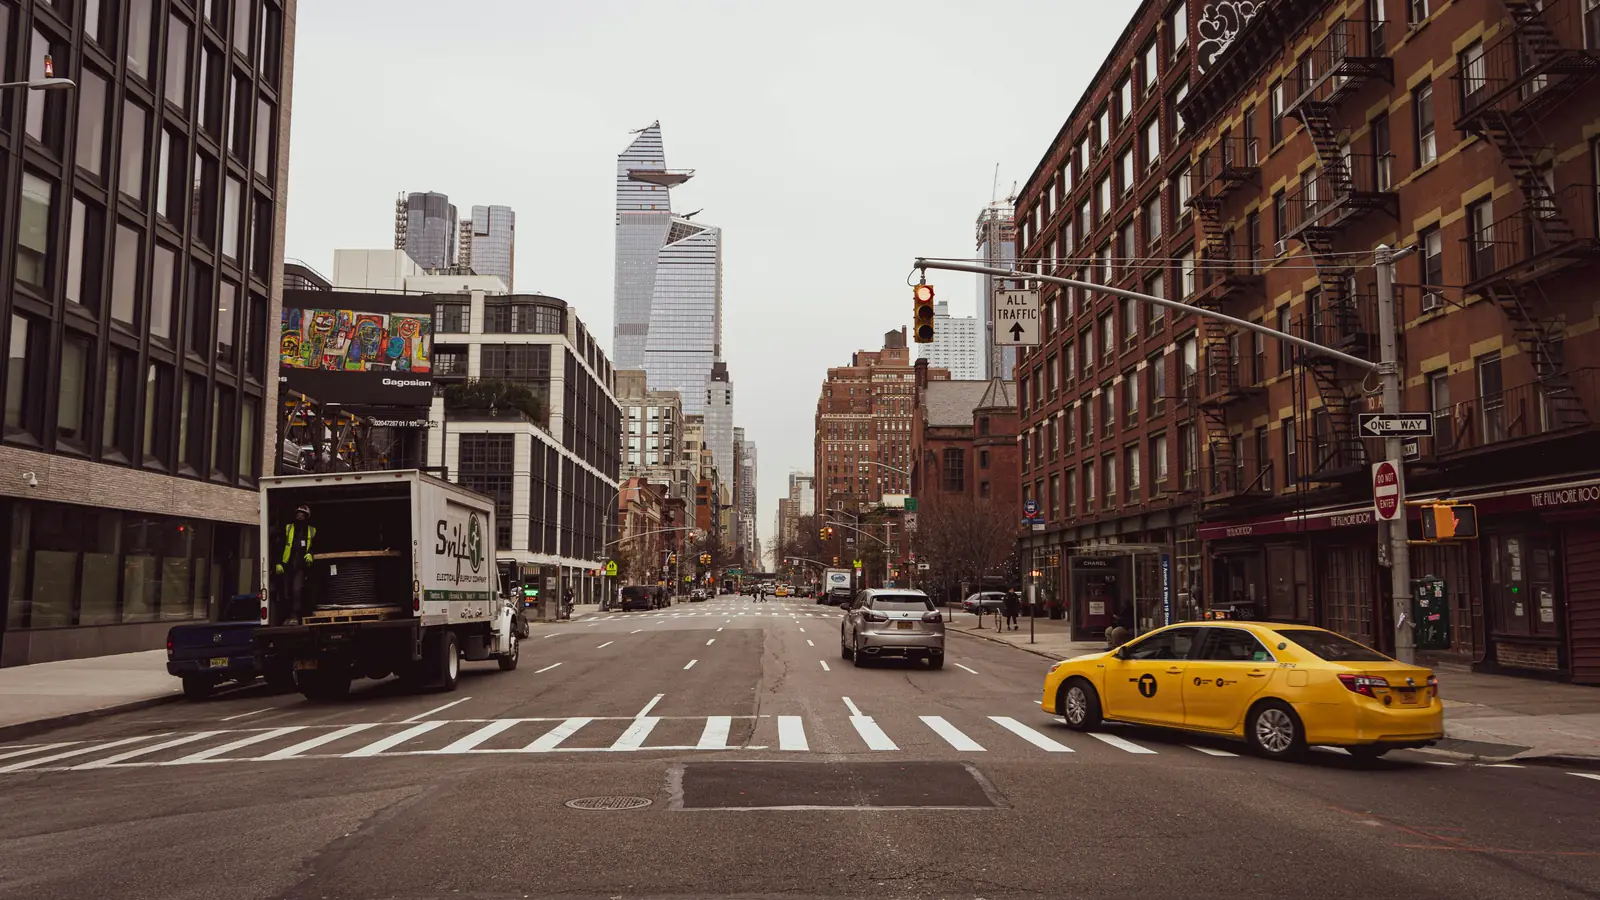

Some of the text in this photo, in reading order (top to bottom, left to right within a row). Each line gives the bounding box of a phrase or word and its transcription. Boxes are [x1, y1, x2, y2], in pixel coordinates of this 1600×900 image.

[1006, 295, 1028, 306] ALL
[997, 308, 1037, 320] TRAFFIC
[382, 378, 431, 388] Gagosian
[1371, 420, 1422, 430] ONE WAY
[1377, 472, 1395, 484] DO NOT
[1531, 486, 1600, 507] THE FILLMORE ROO
[1380, 498, 1394, 509] ENTER
[1356, 512, 1371, 524] ROOM
[1142, 678, 1153, 695] T
